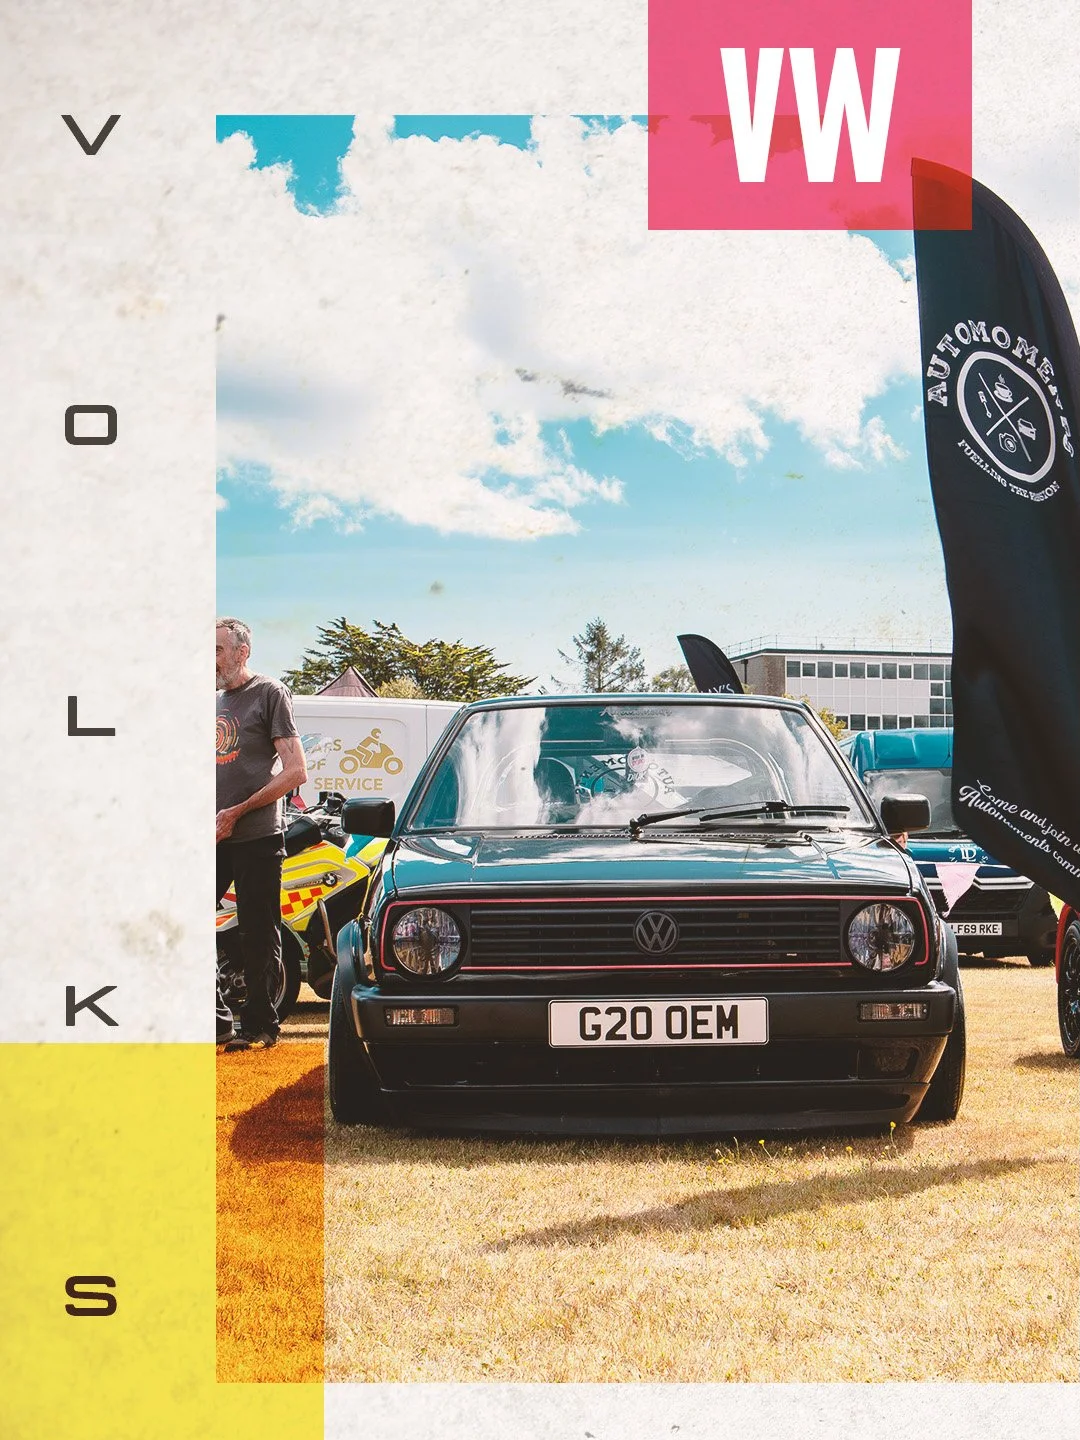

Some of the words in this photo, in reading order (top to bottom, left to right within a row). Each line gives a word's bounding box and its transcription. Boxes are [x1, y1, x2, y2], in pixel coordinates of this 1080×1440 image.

[957, 439, 1007, 487] FUELLING
[313, 777, 383, 791] SERVICE
[958, 785, 1052, 853] Automoments
[976, 779, 1018, 814] Come
[1020, 808, 1047, 829] and
[1041, 823, 1072, 847] join
[980, 924, 998, 934] RKE
[579, 1006, 653, 1041] G20
[665, 1004, 739, 1040] OEM
